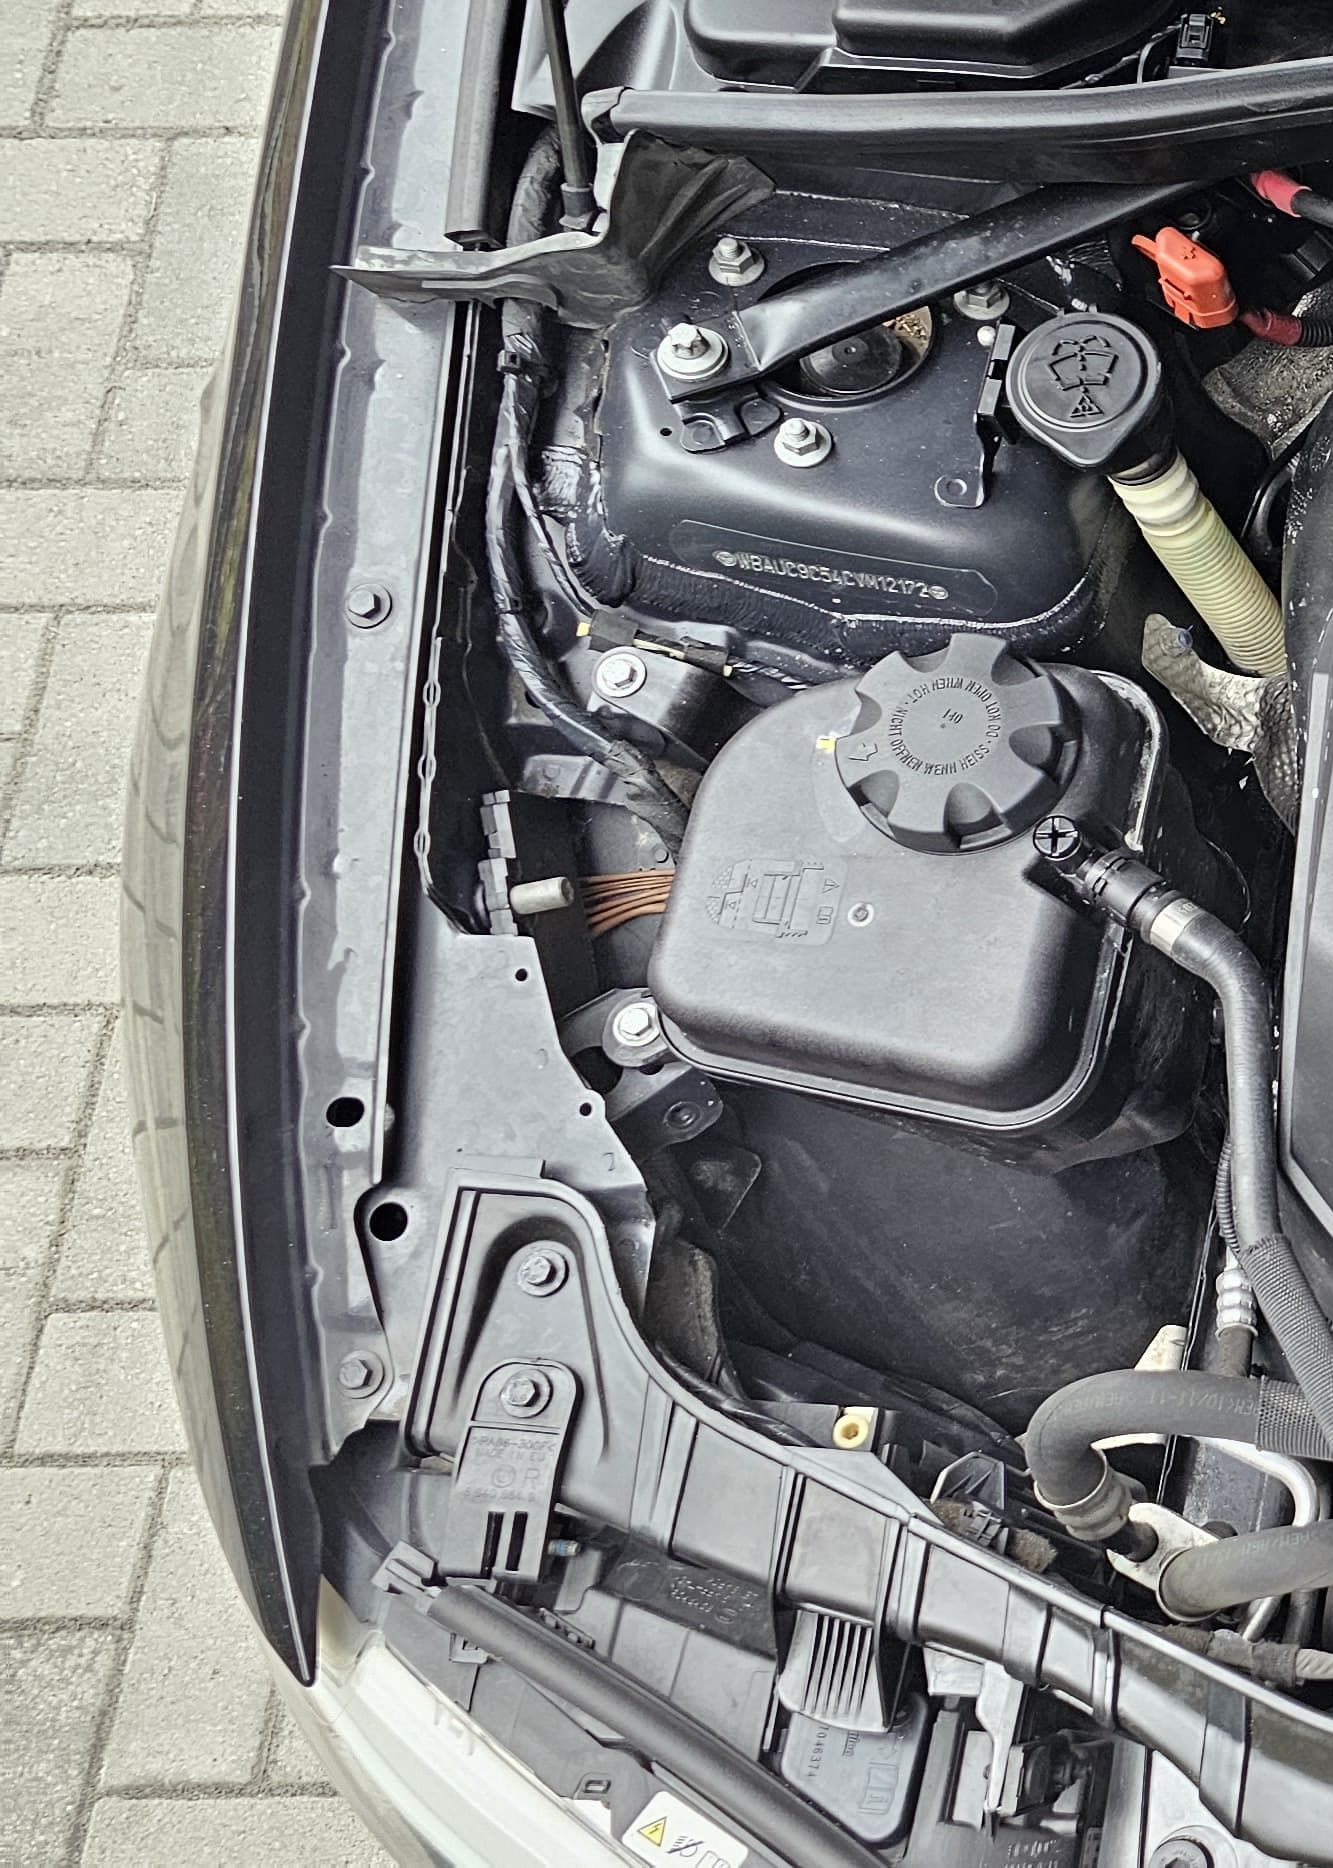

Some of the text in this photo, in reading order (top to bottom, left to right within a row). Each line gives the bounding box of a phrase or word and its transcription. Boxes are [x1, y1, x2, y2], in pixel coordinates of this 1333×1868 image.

[907, 676, 1002, 739] DO NOT OPEN WHEN HOT
[887, 706, 909, 737] NICHT
[923, 761, 957, 776] WENN
[959, 744, 990, 772] HEISS
